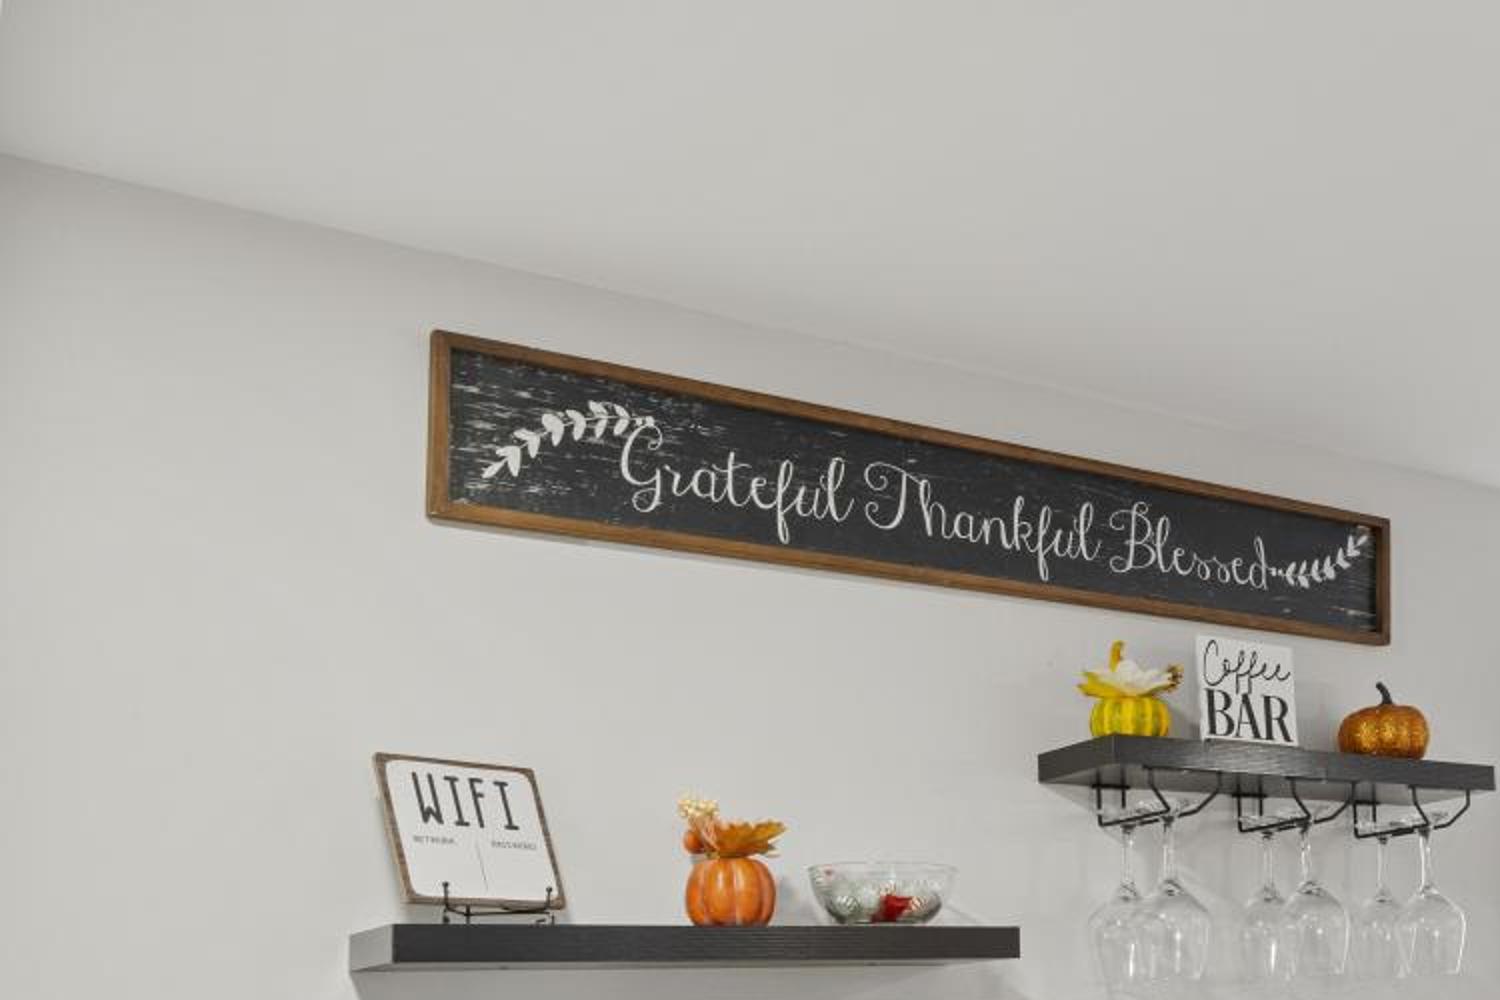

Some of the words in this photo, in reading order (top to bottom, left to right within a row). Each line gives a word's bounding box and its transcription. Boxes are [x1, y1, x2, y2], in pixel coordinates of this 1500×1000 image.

[620, 424, 854, 544] Grateful
[864, 461, 1103, 582] Thankful
[1109, 501, 1270, 590] Blessed
[1203, 639, 1291, 694] Coffee
[1204, 687, 1294, 742] BAR
[411, 771, 520, 830] WIFI
